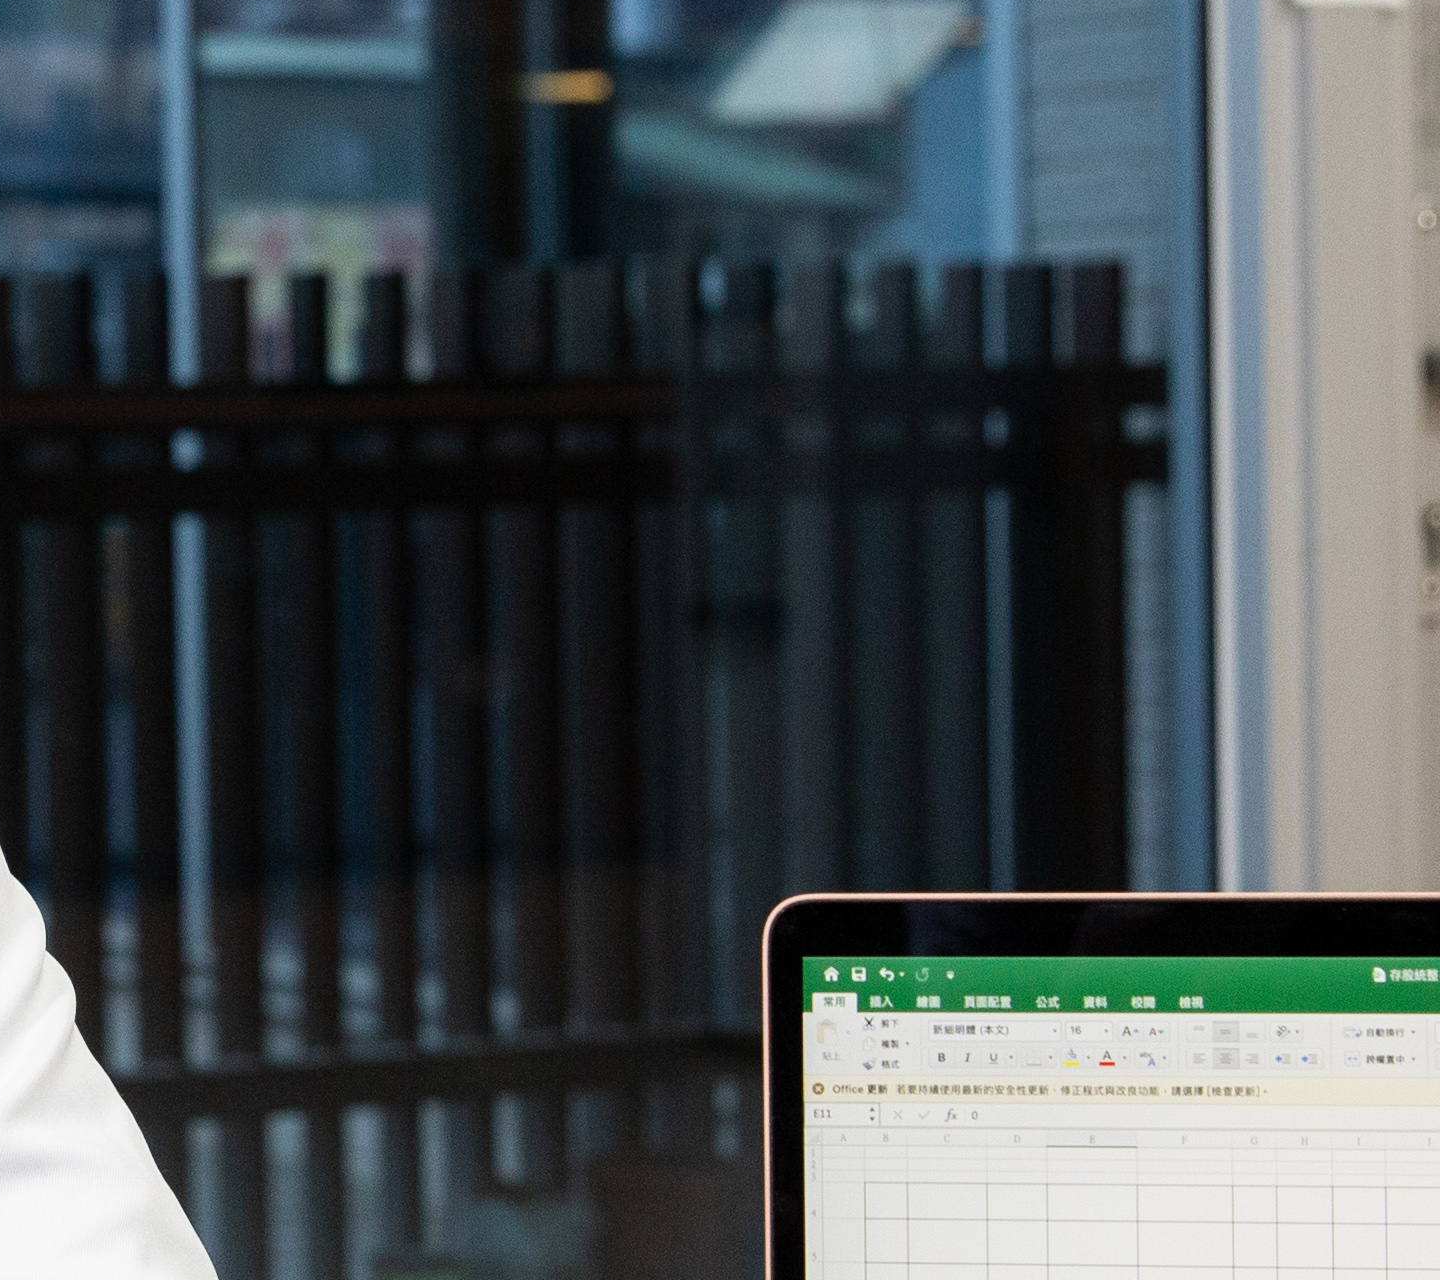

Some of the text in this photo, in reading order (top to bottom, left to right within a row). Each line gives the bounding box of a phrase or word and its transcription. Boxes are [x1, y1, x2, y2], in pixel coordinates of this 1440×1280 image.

[823, 996, 846, 1008] 常用
[1036, 996, 1060, 1008] 公式
[1070, 1026, 1082, 1035] 16
[832, 1085, 864, 1094] Office
[813, 1109, 832, 1118] E11
